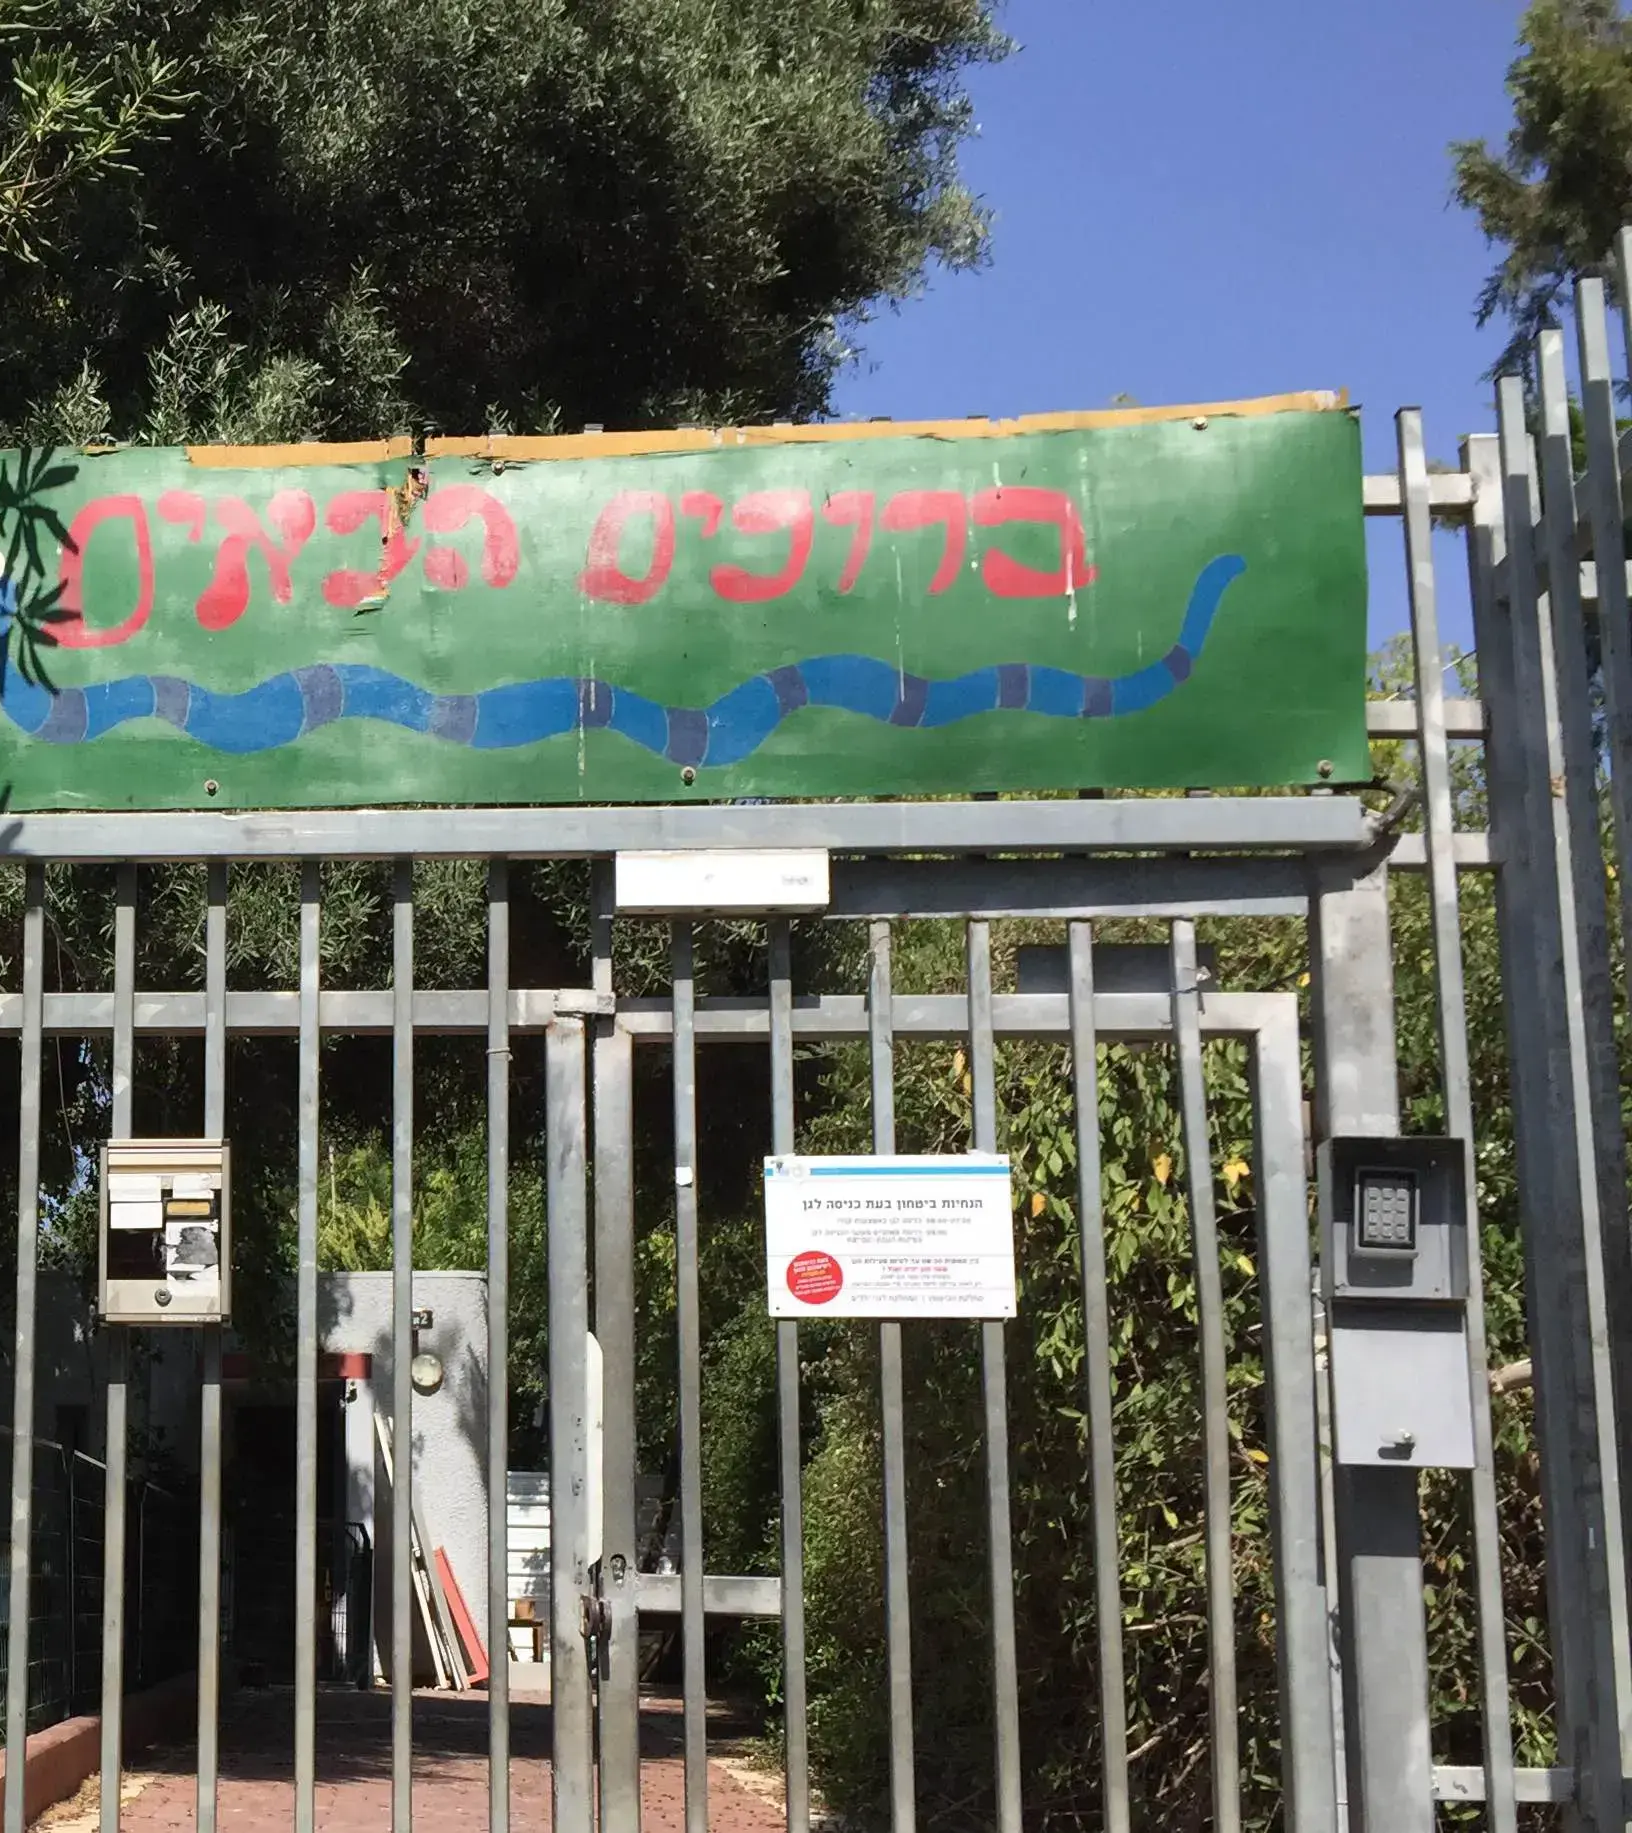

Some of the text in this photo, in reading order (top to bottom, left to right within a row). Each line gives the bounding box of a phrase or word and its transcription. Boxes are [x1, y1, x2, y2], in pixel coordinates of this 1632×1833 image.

[40, 485, 1099, 649] ברוכים הבאים
[802, 1198, 984, 1211] הנחיות ביטחון בעת כניסה לגן
